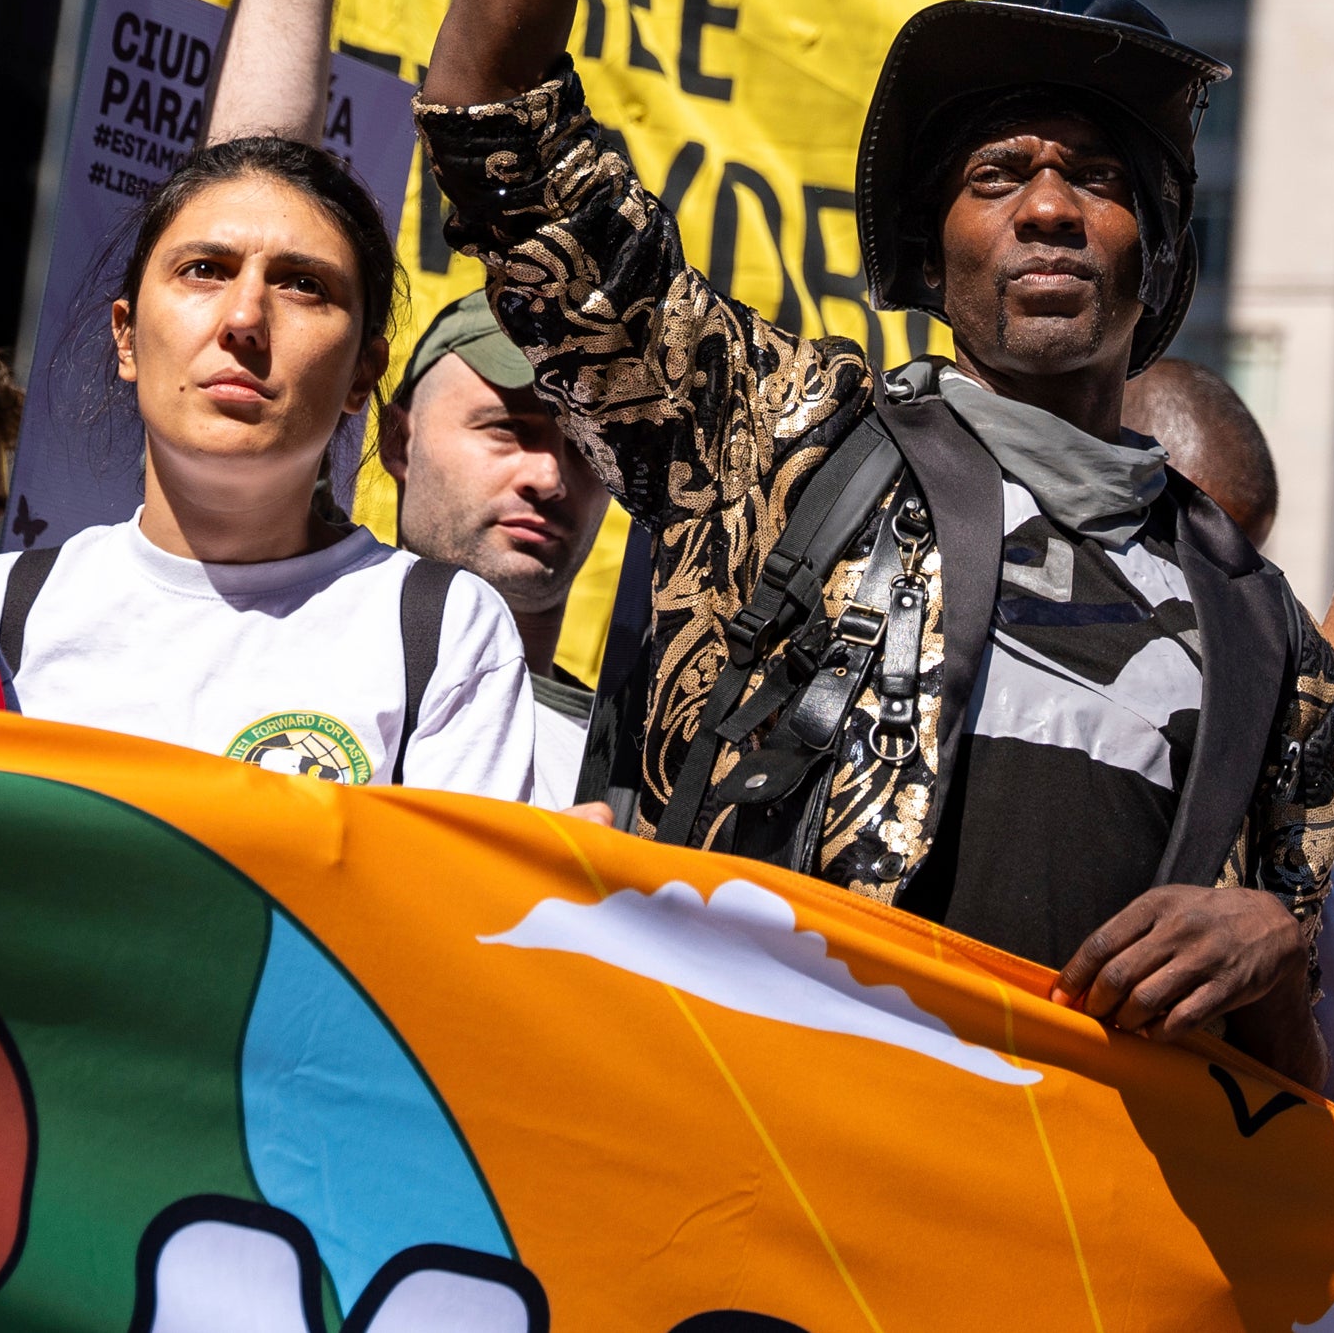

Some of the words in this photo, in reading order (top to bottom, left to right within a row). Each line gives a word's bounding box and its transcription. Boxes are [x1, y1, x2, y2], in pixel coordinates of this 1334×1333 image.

[251, 715, 315, 739] FORWARD
[318, 717, 345, 740] FOR
[341, 734, 369, 784] LASTING
